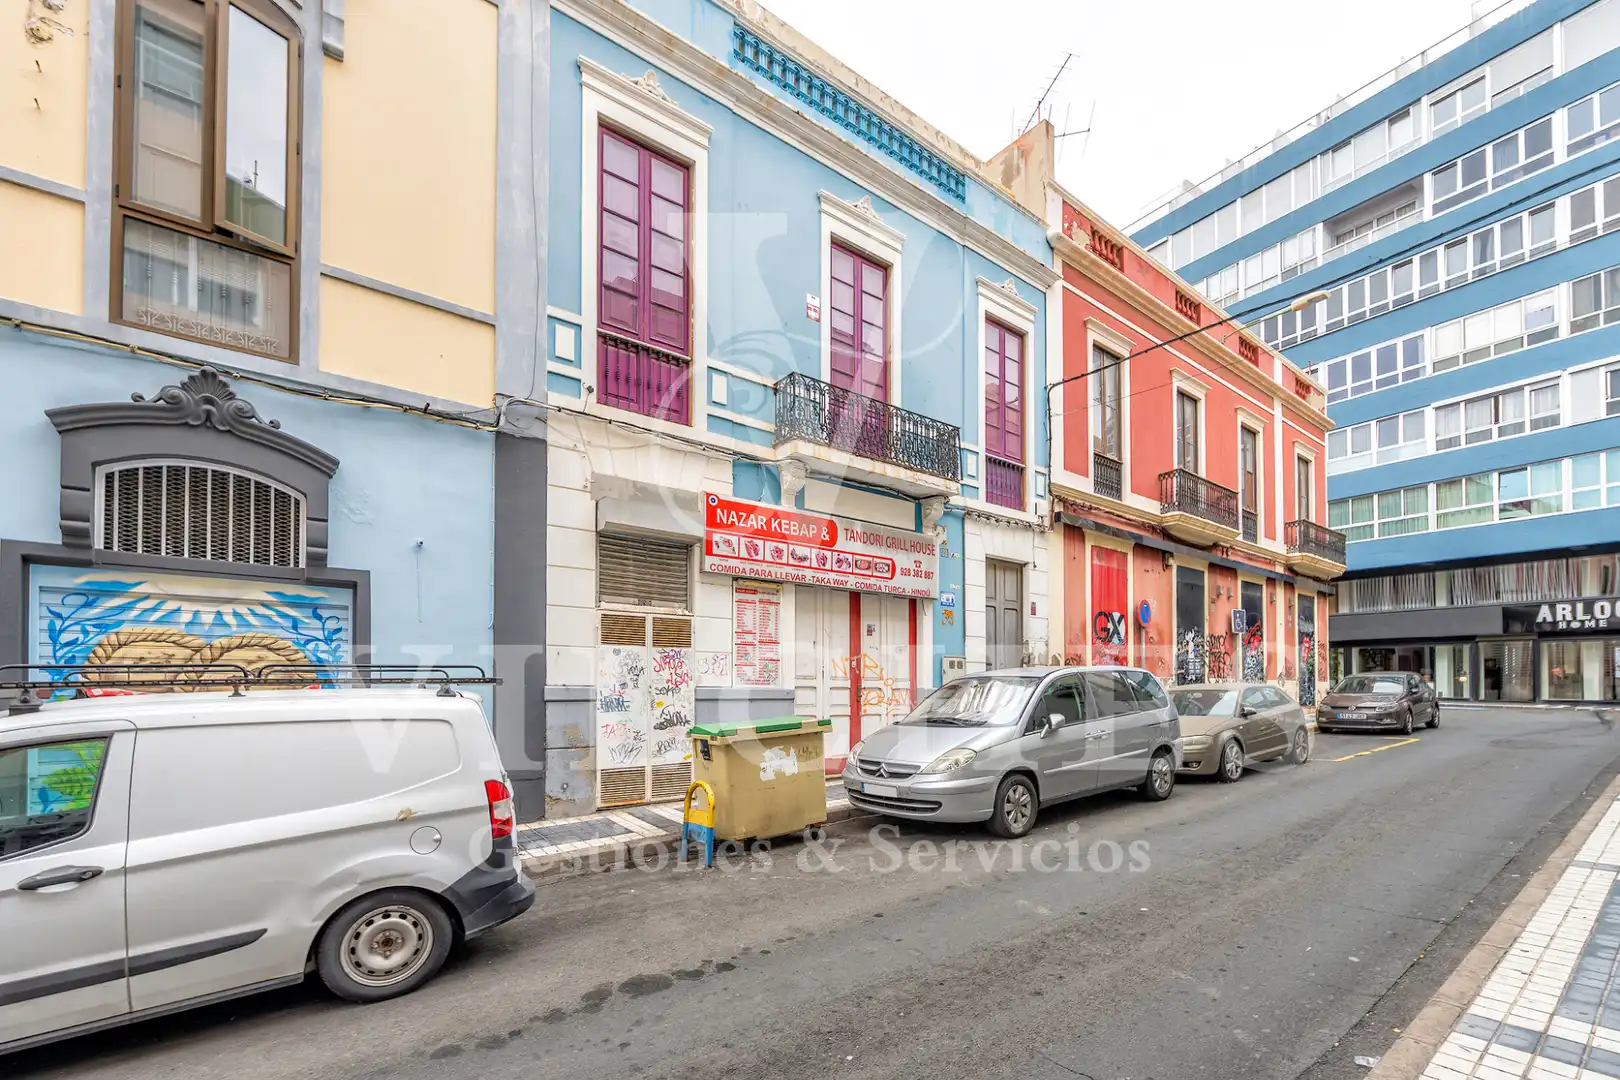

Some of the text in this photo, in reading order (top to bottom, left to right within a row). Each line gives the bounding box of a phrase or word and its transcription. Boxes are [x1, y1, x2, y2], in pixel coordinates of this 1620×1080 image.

[716, 508, 830, 541] NAZAR KEBAP &
[844, 528, 884, 547] TANDORI
[885, 536, 908, 552] GRILL
[910, 540, 936, 556] HOUSE
[709, 562, 747, 575] COMIDA
[749, 568, 773, 579] PARA
[775, 571, 807, 582] LLEVAR
[832, 578, 849, 587] WAY
[854, 580, 882, 591] COMIDA
[883, 584, 906, 594] TURCA
[910, 588, 931, 597] HINDÚ
[900, 567, 911, 576] 928
[912, 568, 923, 579] 382
[1535, 599, 1620, 622] ARLO
[1094, 611, 1125, 643] GX
